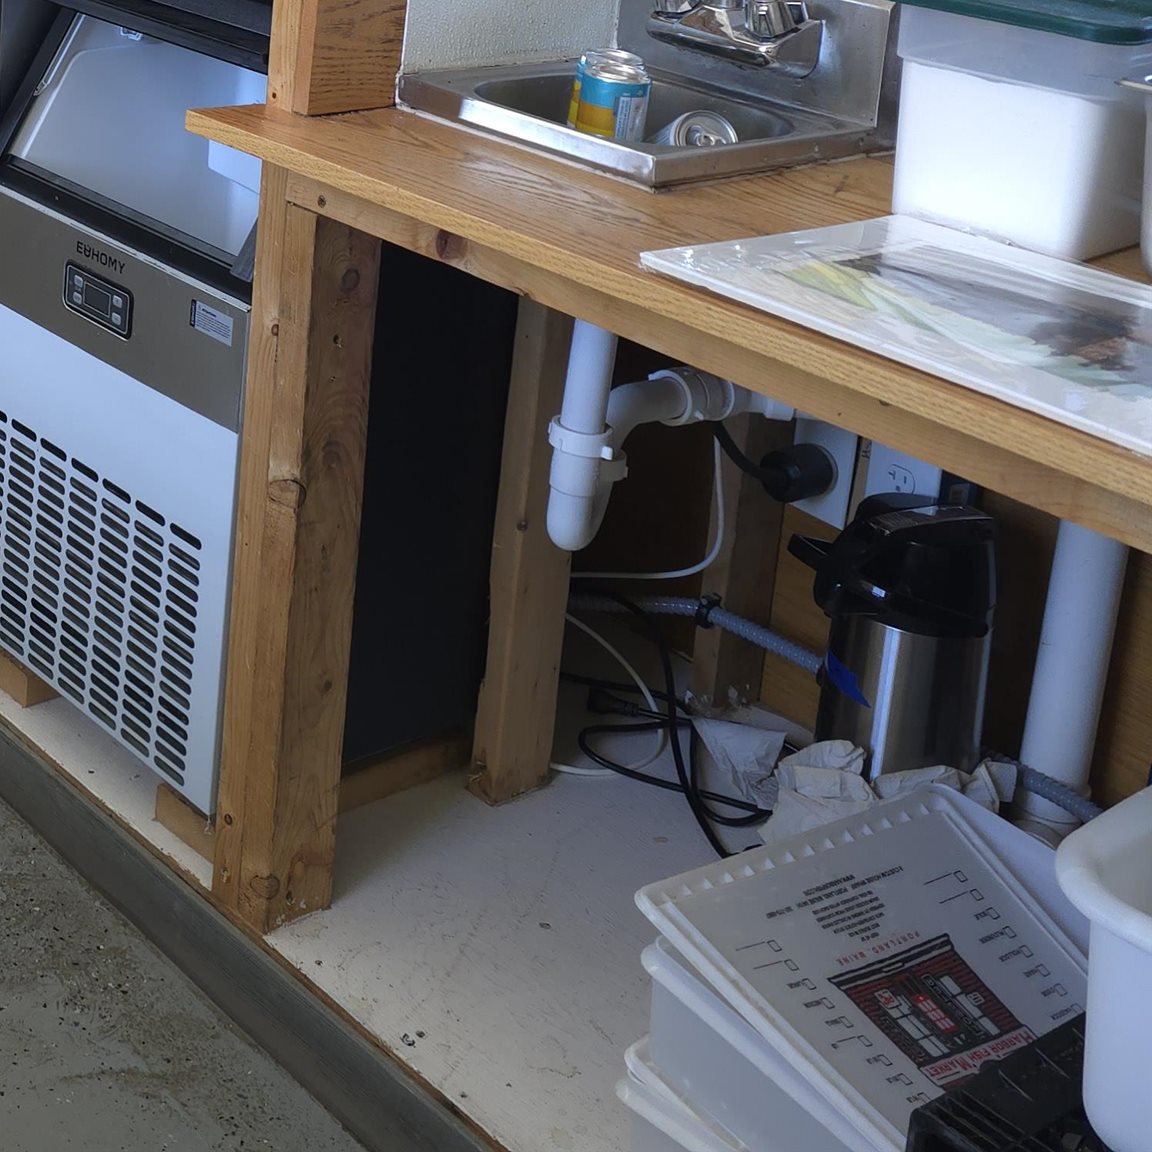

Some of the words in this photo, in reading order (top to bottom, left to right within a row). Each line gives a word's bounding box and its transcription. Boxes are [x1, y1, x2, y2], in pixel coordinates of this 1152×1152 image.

[990, 1030, 1033, 1054] HARBOR
[969, 1048, 991, 1062] FISH
[926, 1056, 973, 1077] MARKET
